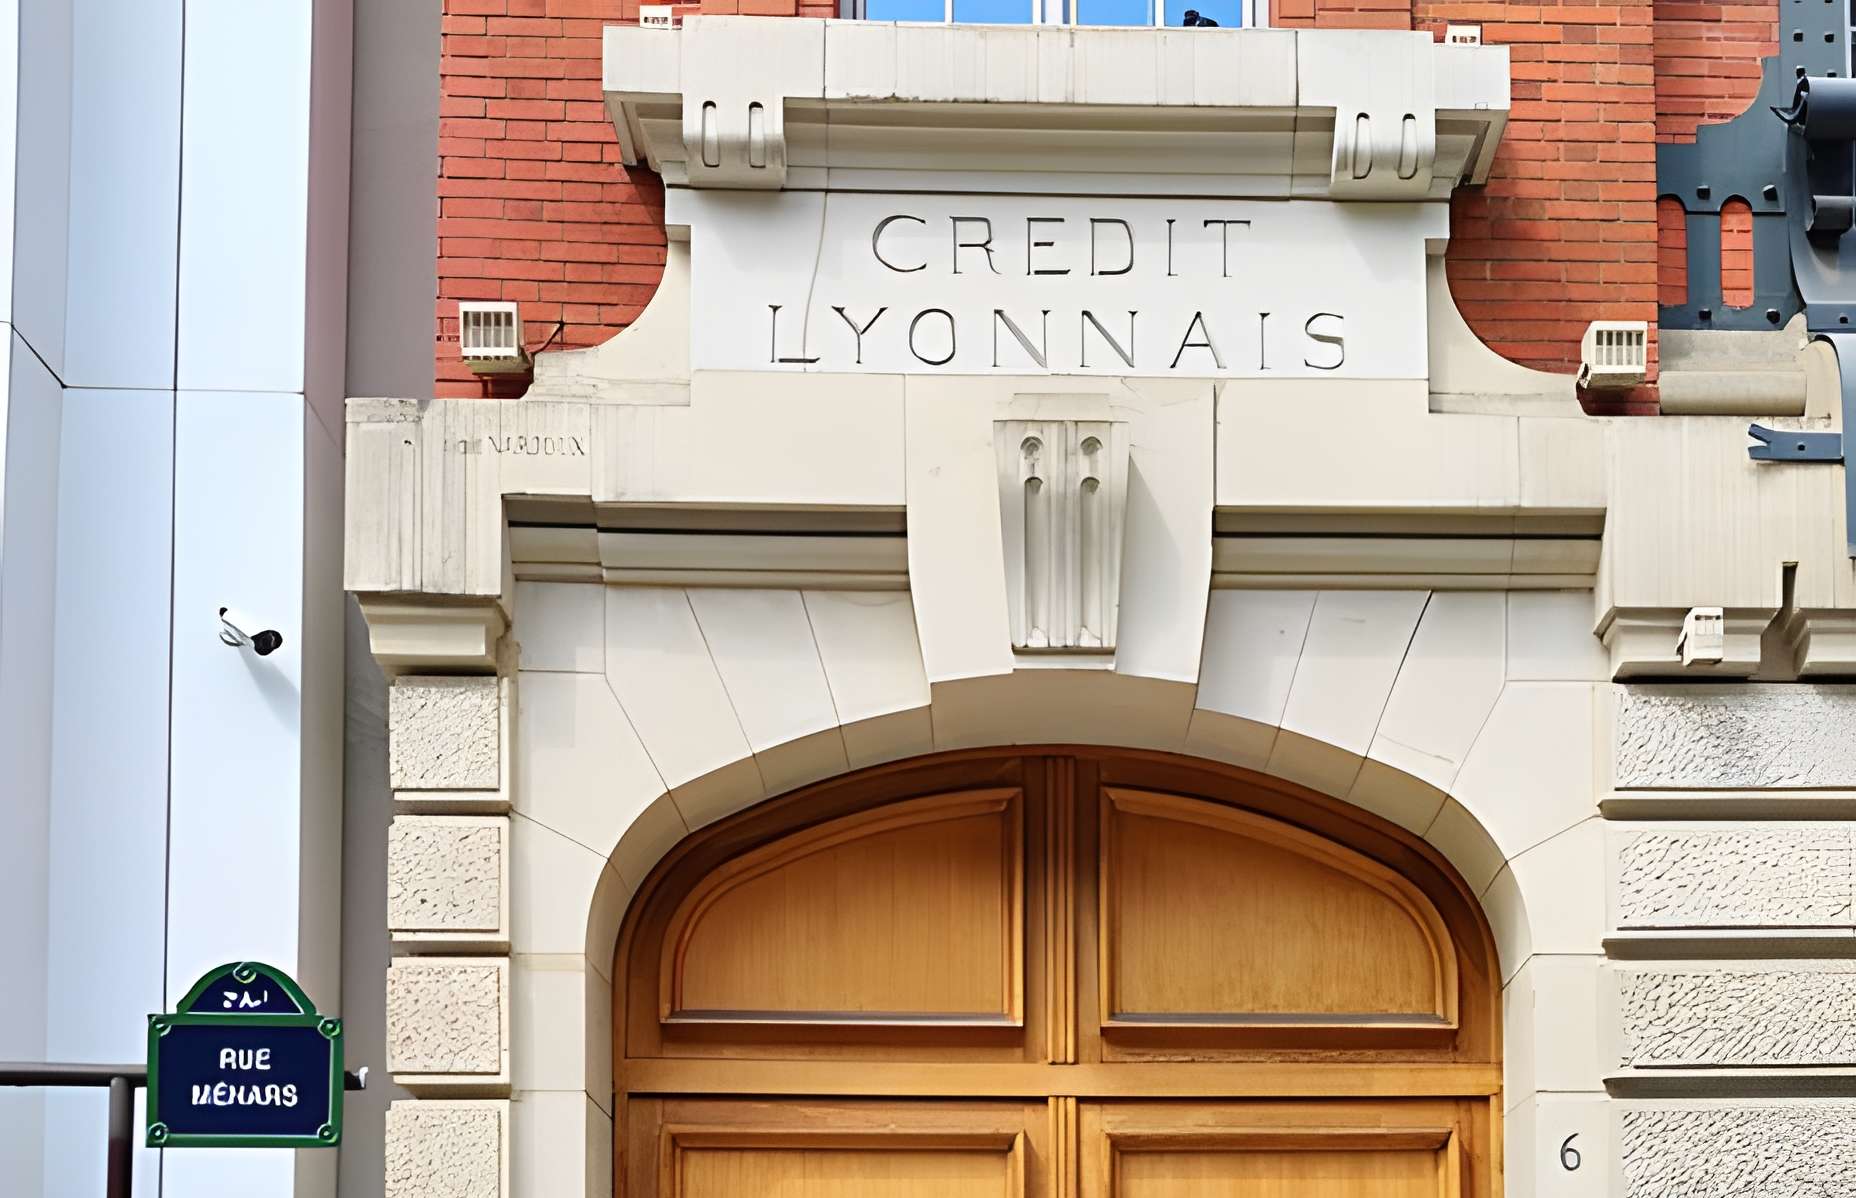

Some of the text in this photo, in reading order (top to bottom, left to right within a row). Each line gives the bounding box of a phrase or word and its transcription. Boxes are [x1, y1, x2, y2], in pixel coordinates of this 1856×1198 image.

[872, 214, 1252, 278] CREDIT
[768, 304, 1346, 371] LYONNAIS
[219, 1047, 272, 1071] RUE
[1560, 1132, 1581, 1172] 6
